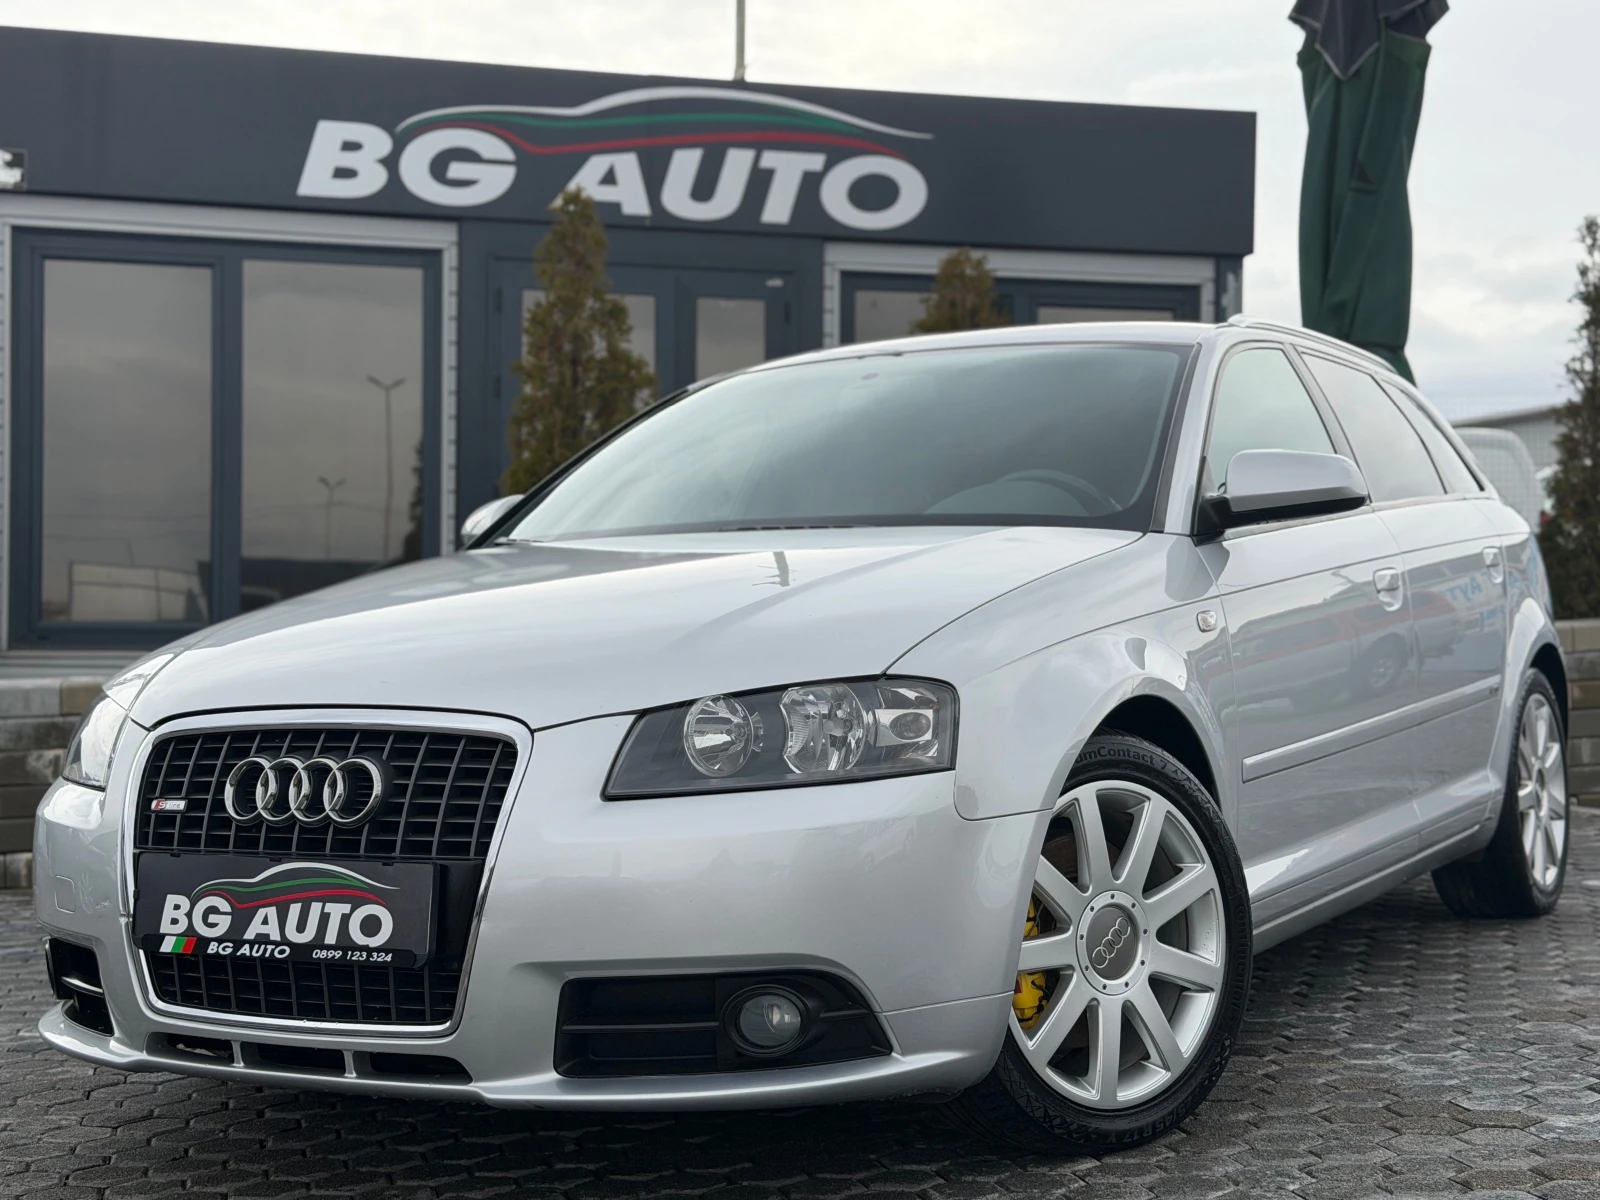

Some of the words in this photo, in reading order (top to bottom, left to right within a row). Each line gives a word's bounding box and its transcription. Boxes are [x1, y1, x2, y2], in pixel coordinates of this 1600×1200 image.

[296, 119, 517, 207] BG
[548, 147, 928, 230] AUTO
[159, 894, 232, 938] BG
[243, 902, 393, 948] AUTO
[207, 942, 234, 955] BG
[236, 944, 290, 958] AUTO
[312, 949, 342, 960] 0899
[346, 951, 367, 961] 123
[370, 952, 393, 962] 324
